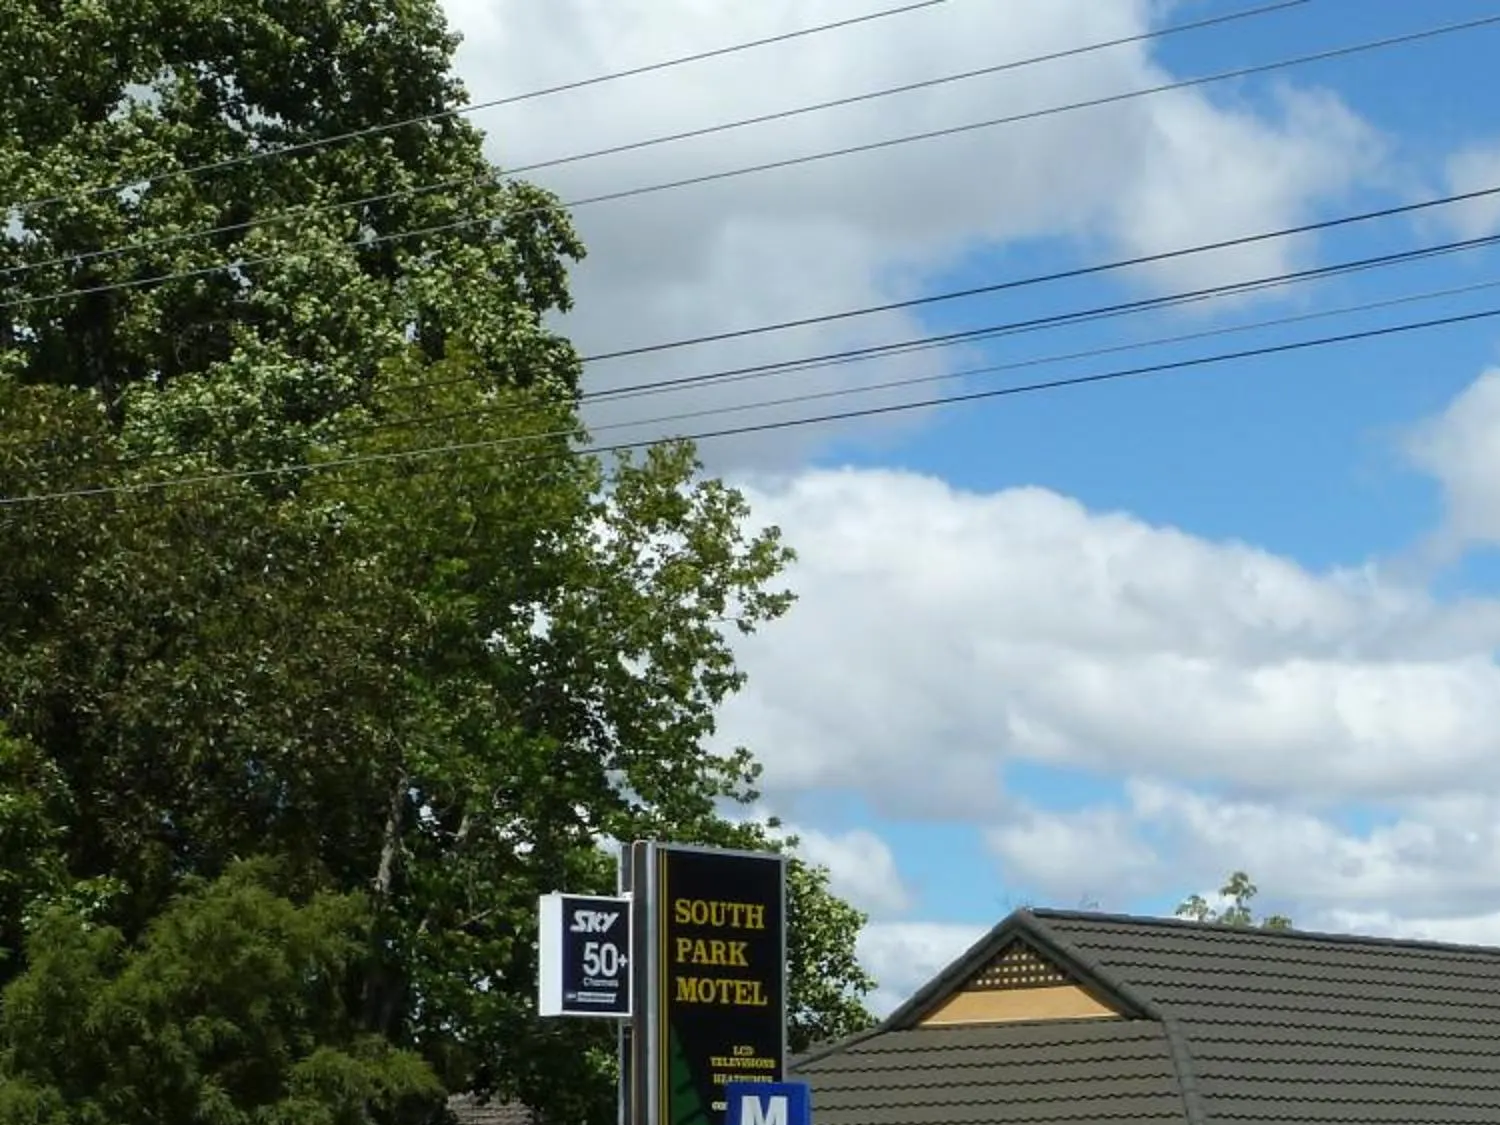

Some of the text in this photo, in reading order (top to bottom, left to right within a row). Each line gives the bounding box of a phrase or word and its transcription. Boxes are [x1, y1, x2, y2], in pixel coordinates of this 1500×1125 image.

[570, 910, 620, 932] SKY
[675, 898, 765, 929] SOUTH
[676, 937, 749, 967] PARK
[676, 976, 768, 1006] MOTEL
